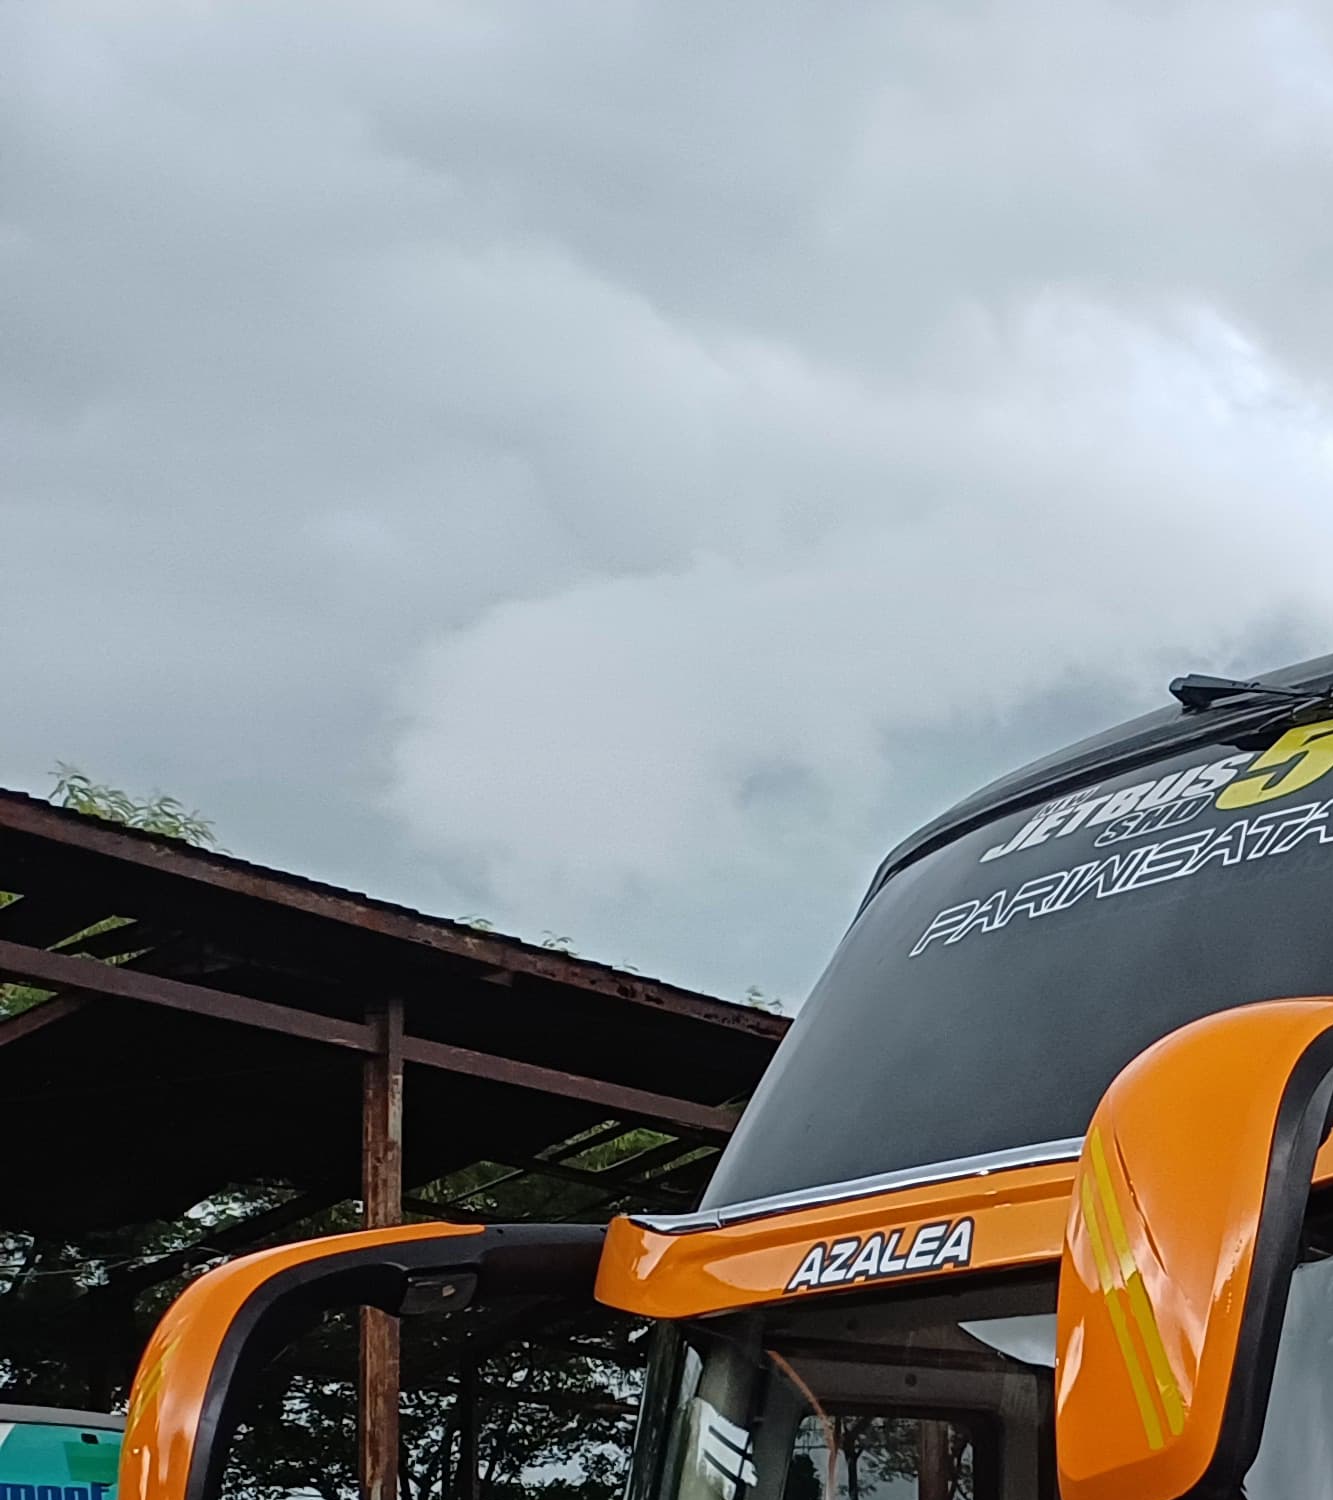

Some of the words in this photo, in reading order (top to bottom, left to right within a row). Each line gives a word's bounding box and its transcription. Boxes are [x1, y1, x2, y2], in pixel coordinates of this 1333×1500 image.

[980, 753, 1254, 863] JETBUS
[1094, 792, 1215, 847] SHD
[784, 1216, 975, 1293] AZALEA
